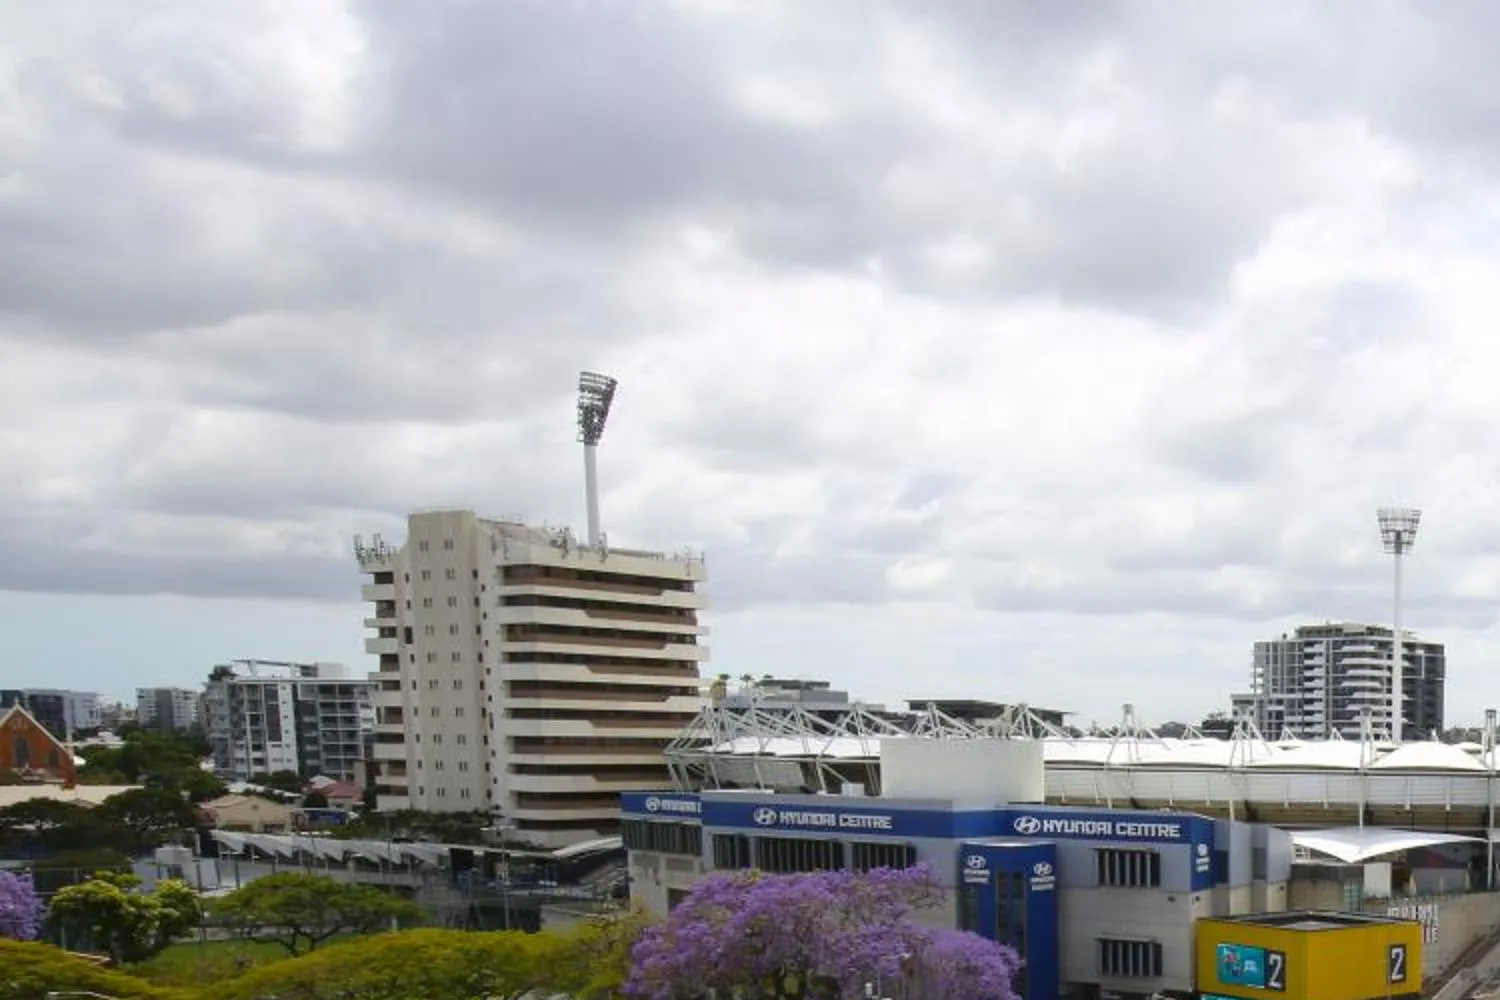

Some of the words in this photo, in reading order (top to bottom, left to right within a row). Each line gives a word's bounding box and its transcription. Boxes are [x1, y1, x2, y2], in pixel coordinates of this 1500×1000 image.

[779, 811, 836, 827] HYUNDAI
[839, 813, 892, 830] CENTRE
[1043, 819, 1112, 836] HYUNDAI
[1115, 821, 1181, 838] CENTRE
[1268, 953, 1282, 989] 2
[1391, 947, 1405, 981] 2
